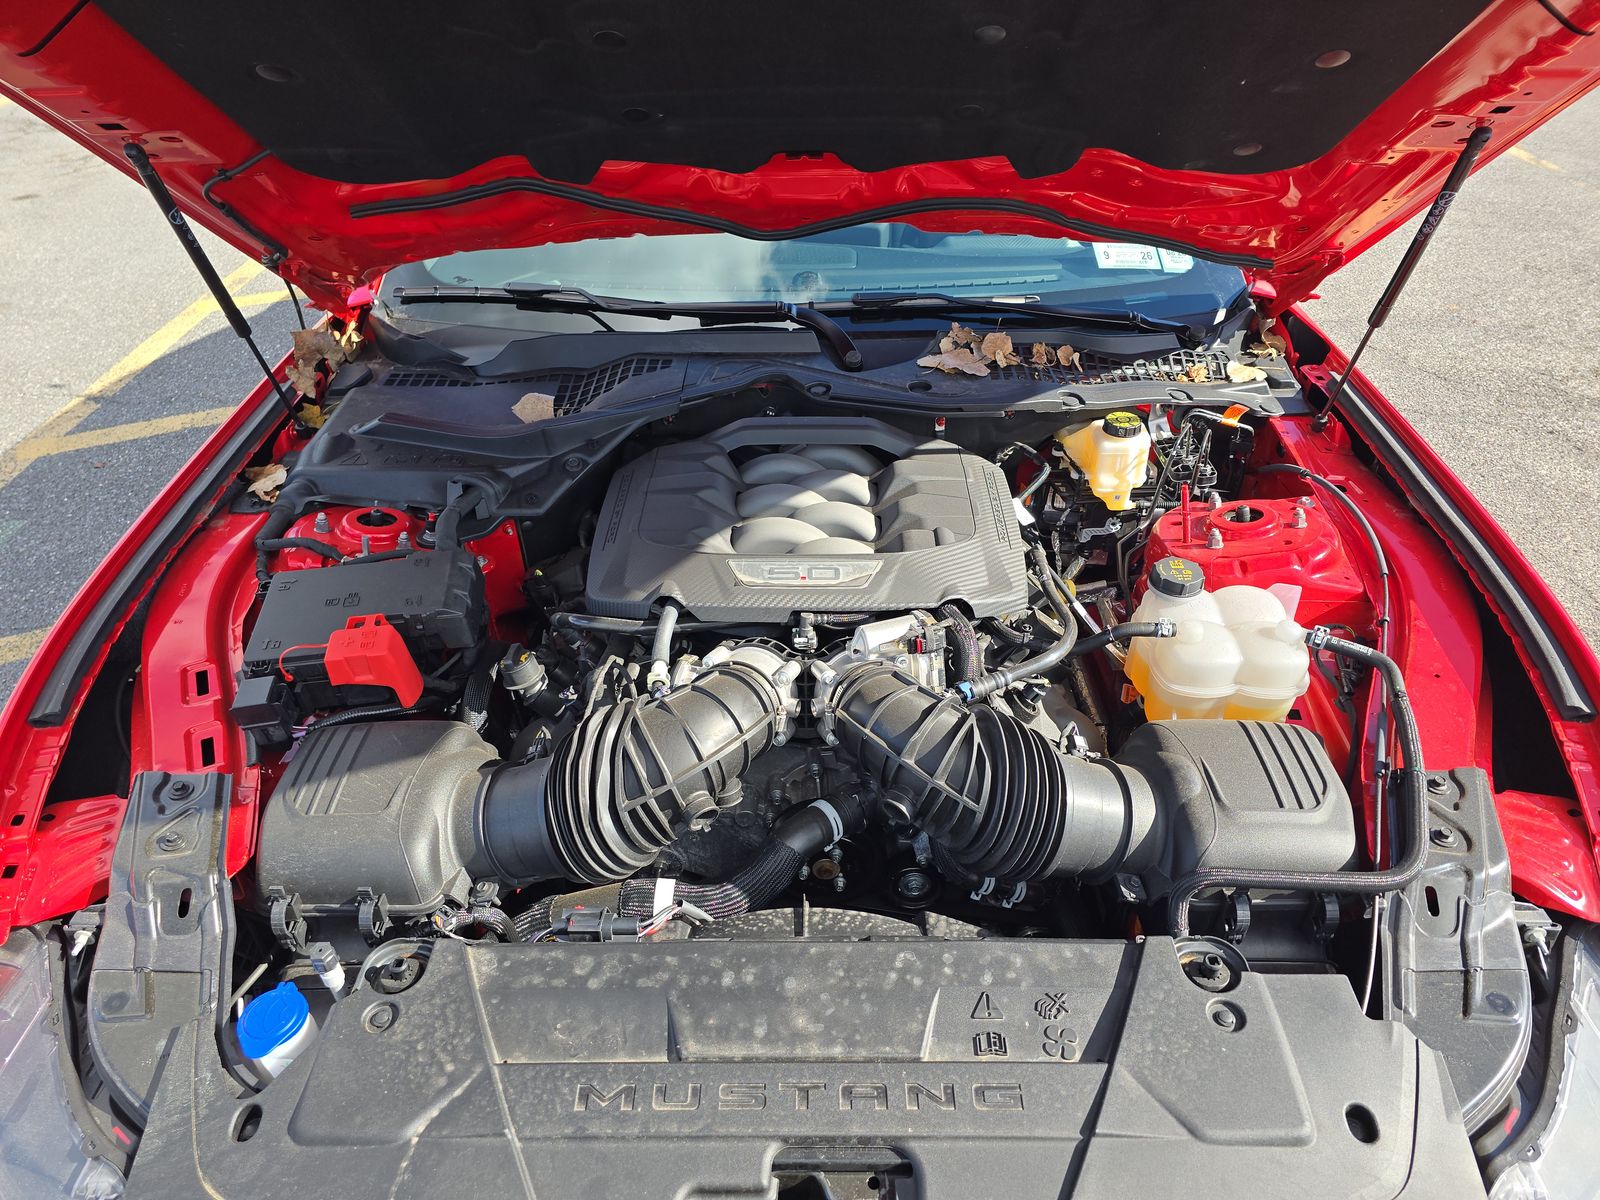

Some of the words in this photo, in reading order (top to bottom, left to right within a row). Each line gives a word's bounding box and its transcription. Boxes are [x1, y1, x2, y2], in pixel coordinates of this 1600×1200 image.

[1103, 251, 1110, 260] 9
[1140, 251, 1153, 261] 26
[767, 566, 841, 581] 5.0
[573, 1083, 1025, 1111] MUSTANG
